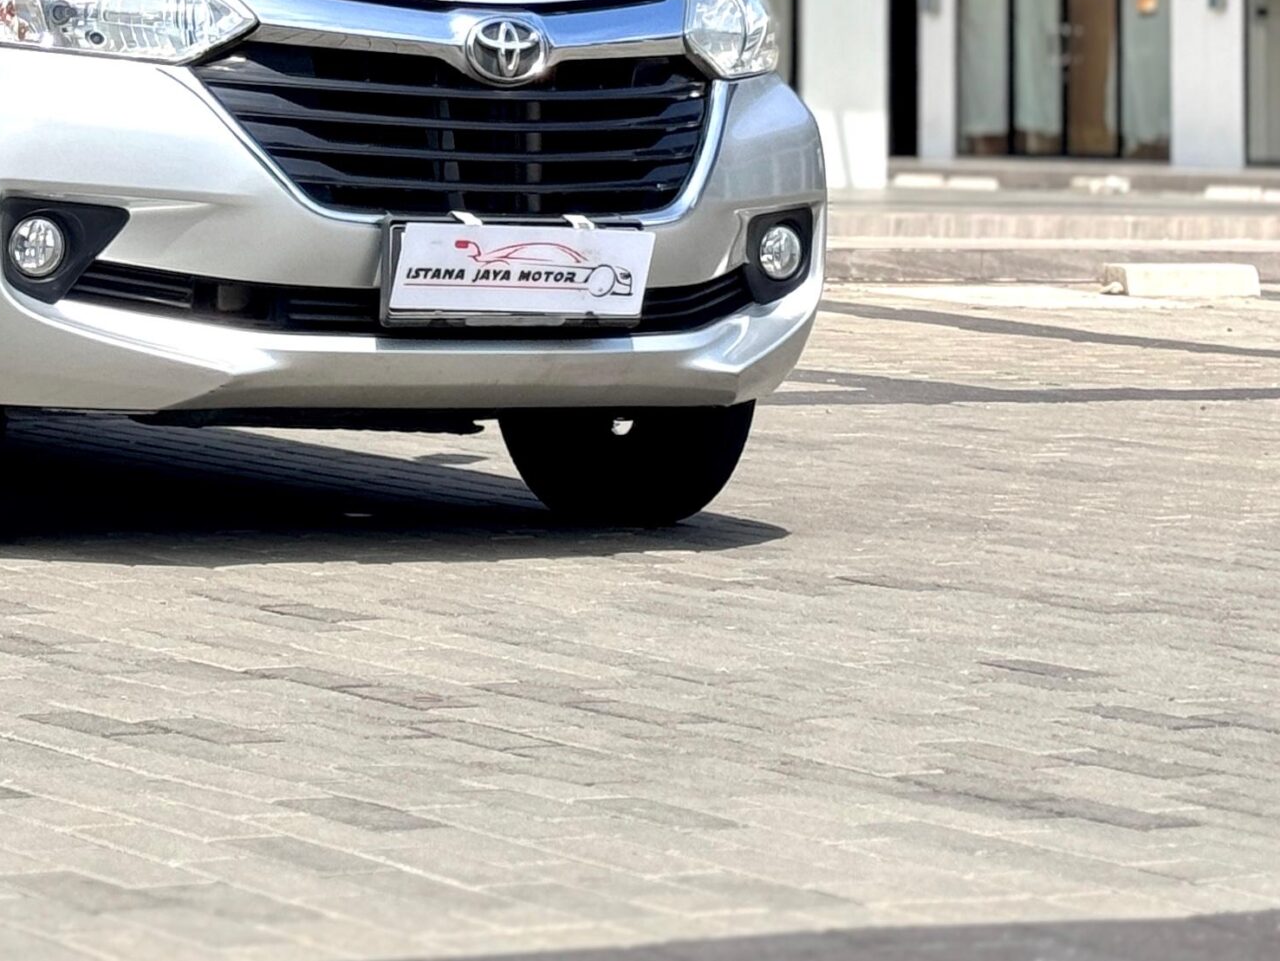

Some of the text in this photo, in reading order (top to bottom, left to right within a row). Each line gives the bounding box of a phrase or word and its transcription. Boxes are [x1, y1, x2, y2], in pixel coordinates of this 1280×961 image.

[405, 267, 577, 284] ISTANA JAYA MOTOR
